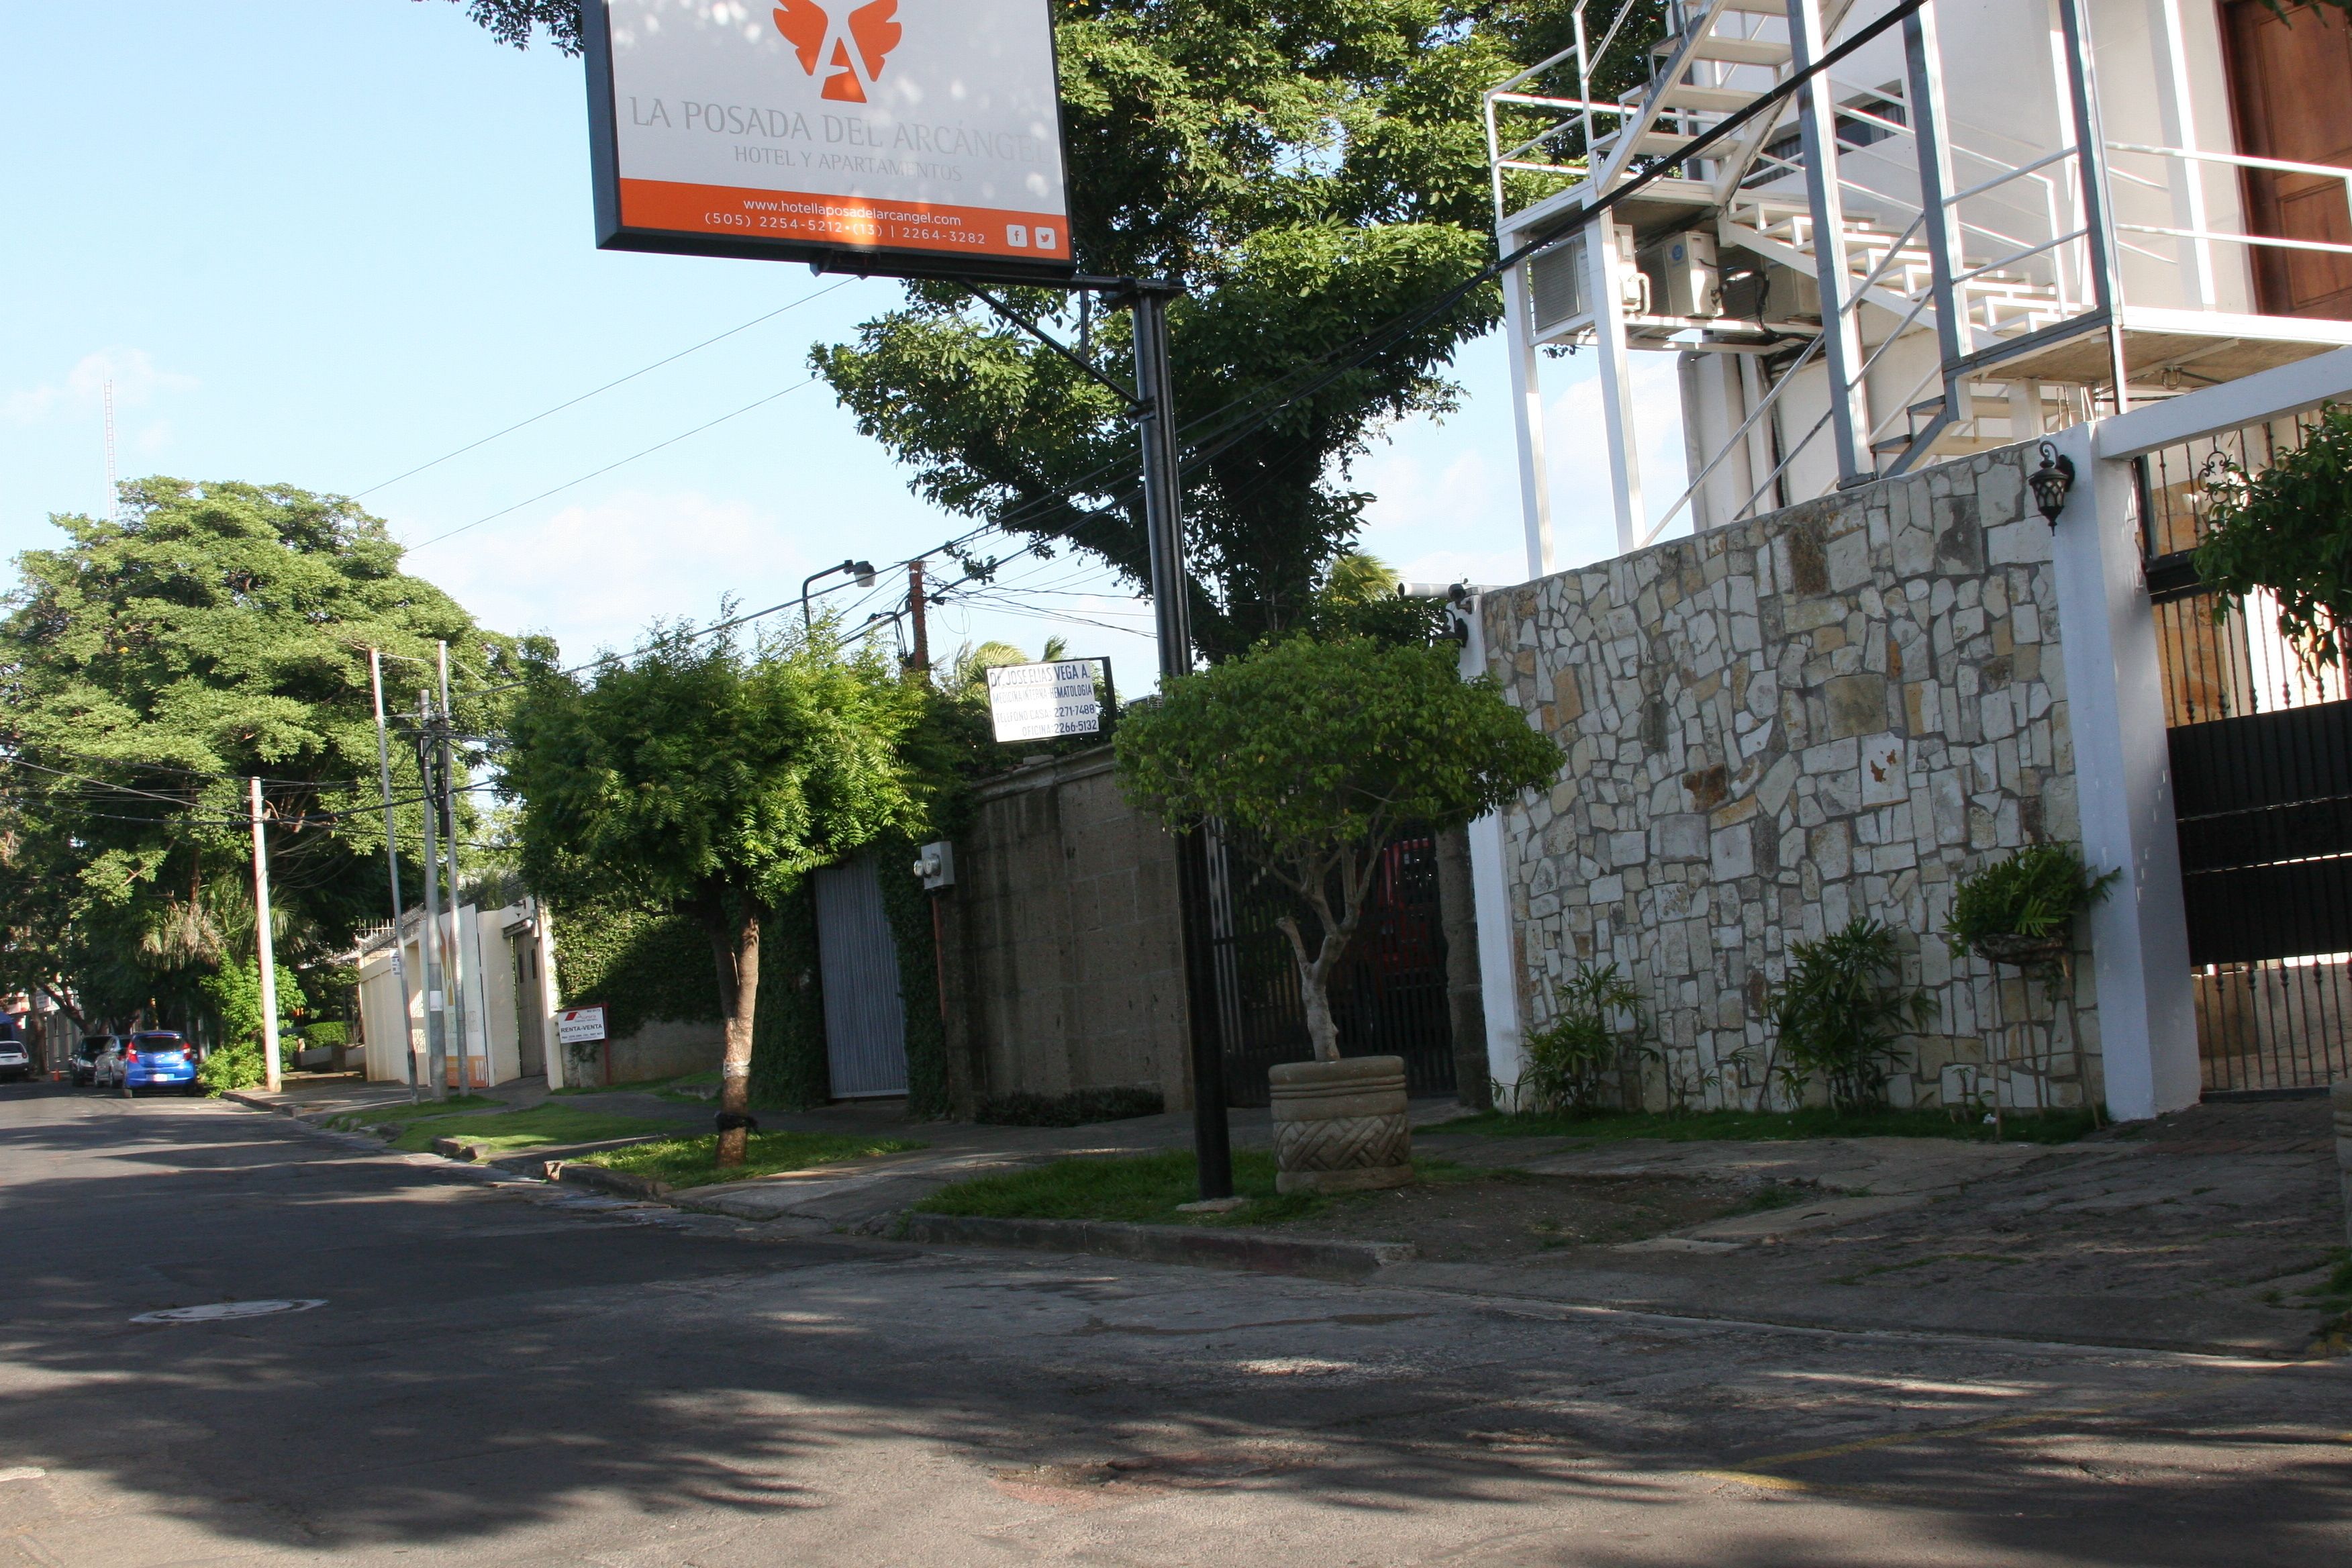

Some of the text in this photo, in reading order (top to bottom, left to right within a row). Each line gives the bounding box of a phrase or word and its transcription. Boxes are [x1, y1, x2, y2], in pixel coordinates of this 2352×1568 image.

[629, 96, 672, 128] LA
[681, 100, 812, 141] POSADA
[822, 114, 883, 148] DEL
[734, 145, 963, 182] HOTEL Y APARTAMENTOS
[743, 199, 962, 226] www.hotellaposadelarcangel.com
[705, 211, 752, 228] (505)
[902, 226, 985, 244] 2264-3282
[1054, 665, 1079, 681] VEGA
[1081, 663, 1091, 679] A.
[1054, 703, 1095, 718] 2271-7488
[1055, 719, 1097, 734] 2266-5132
[560, 1024, 603, 1032] RENTA-VENTA
